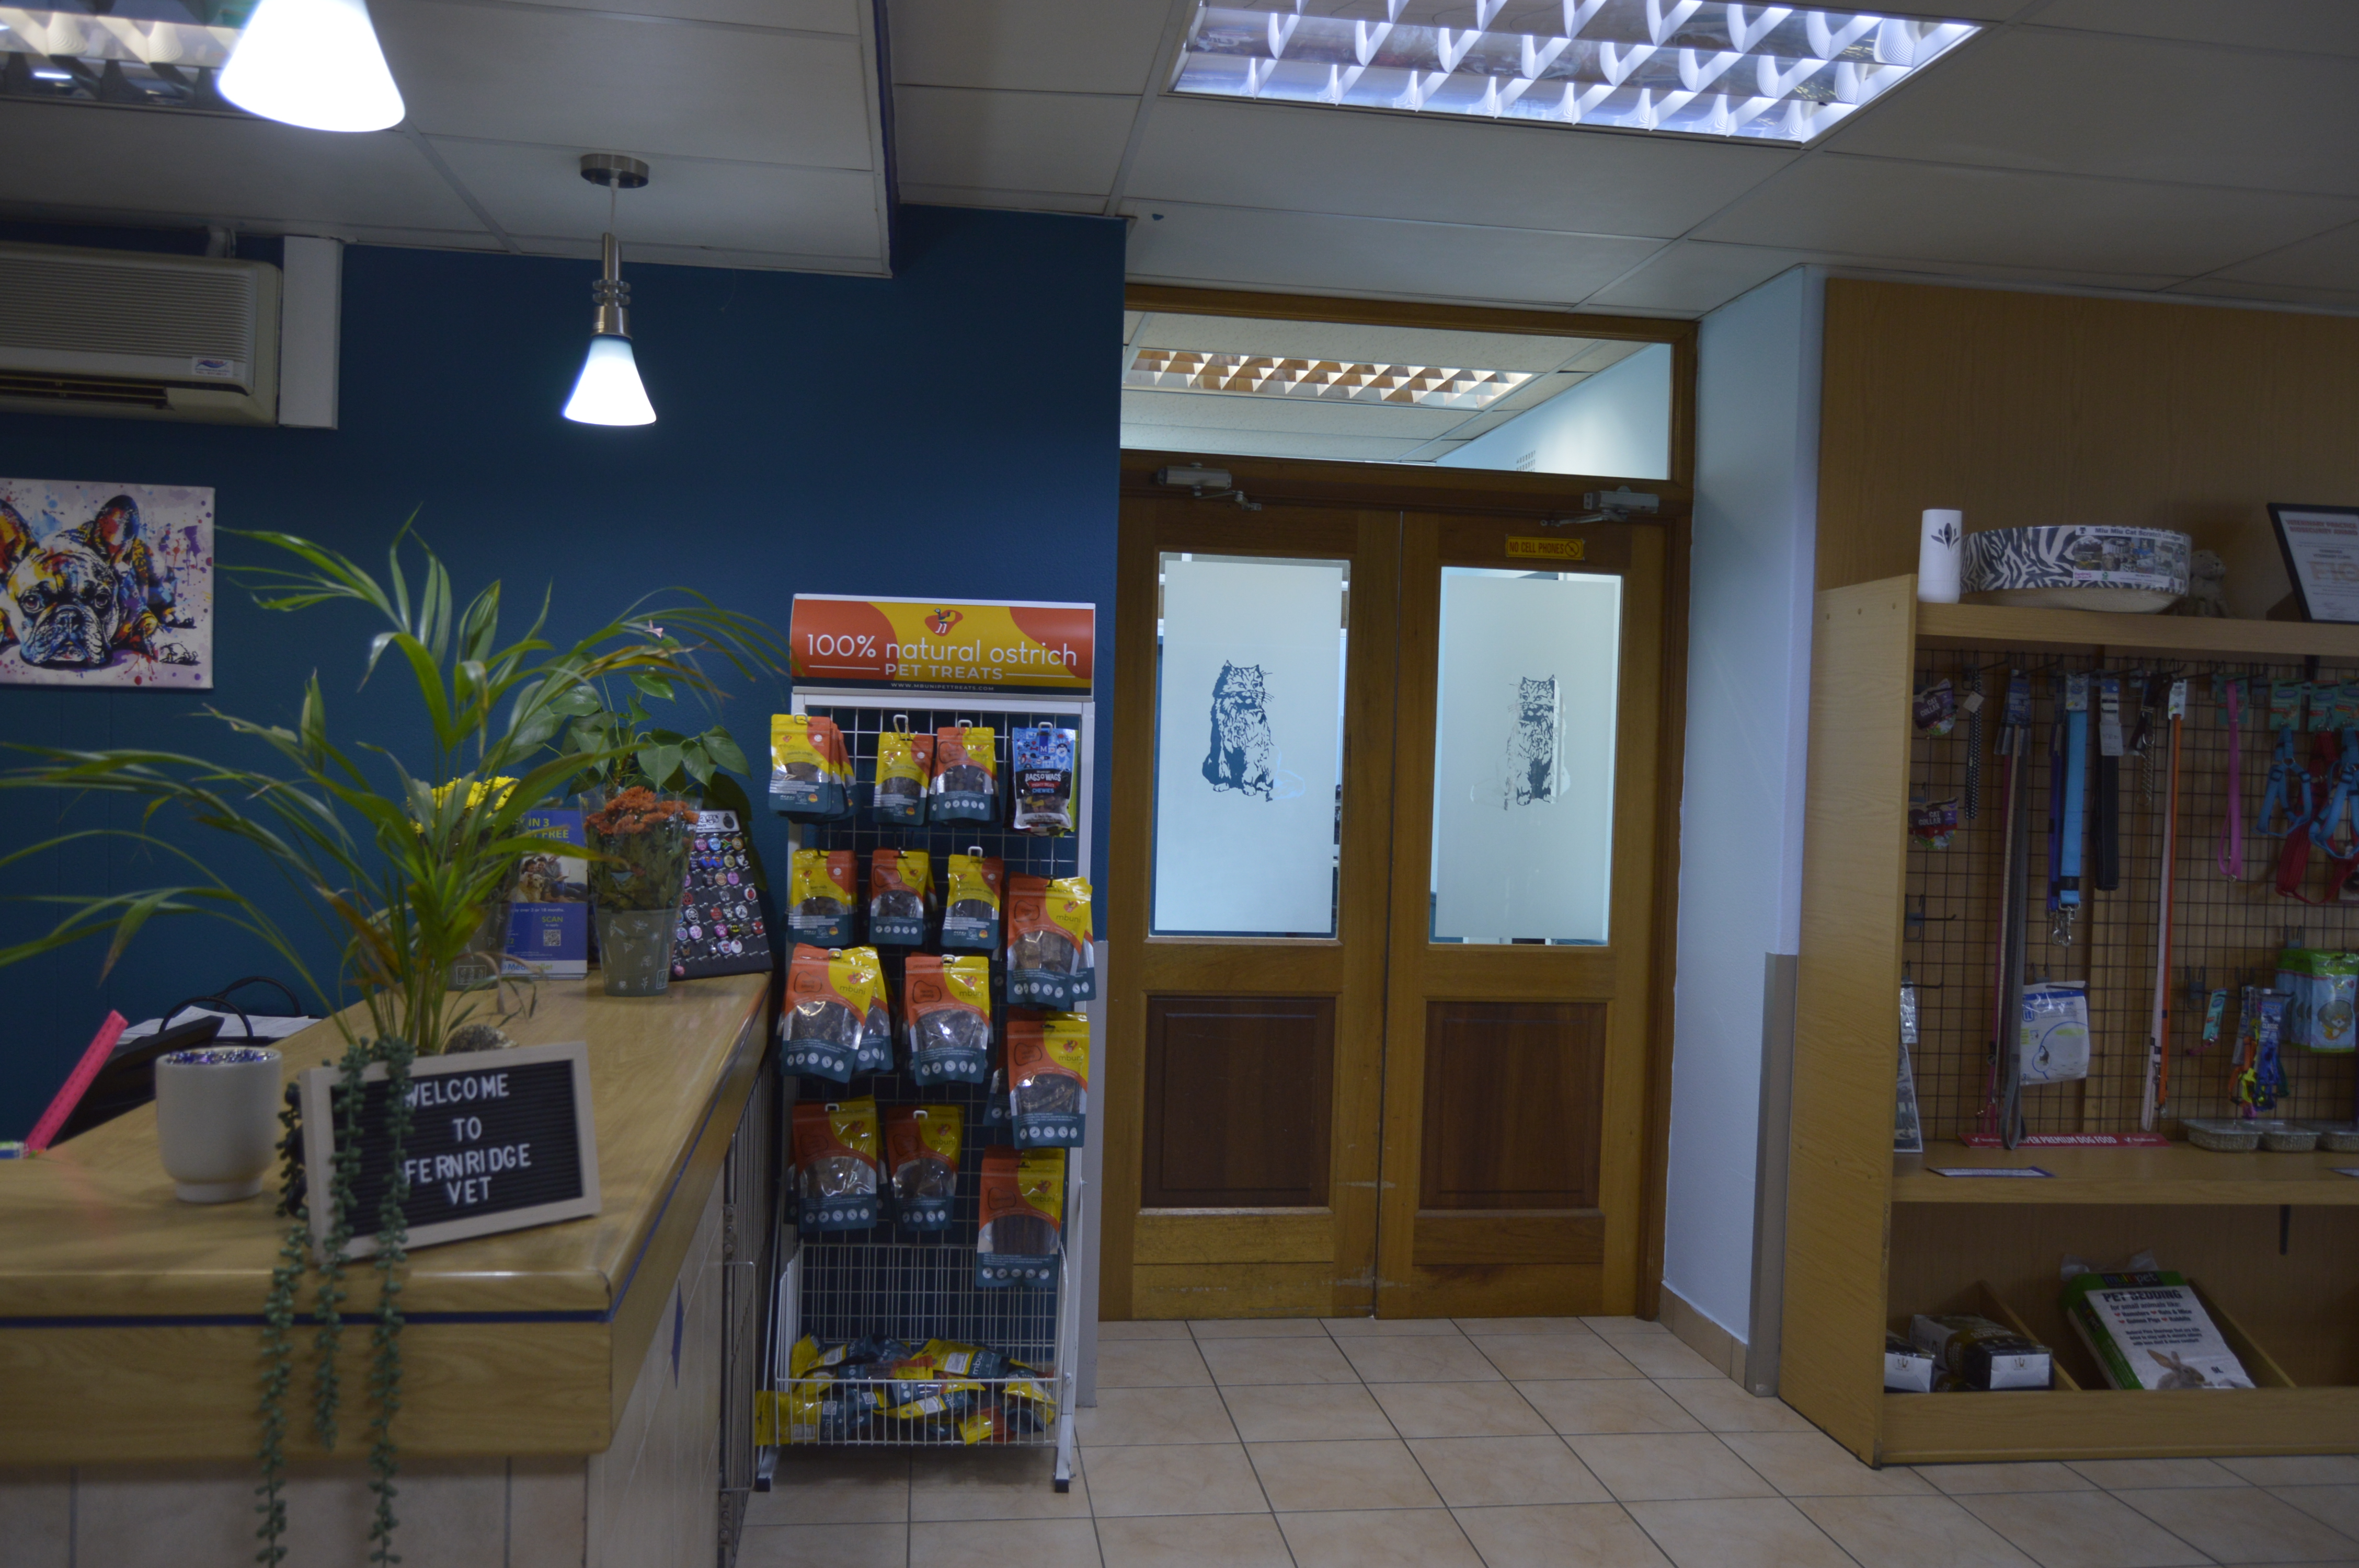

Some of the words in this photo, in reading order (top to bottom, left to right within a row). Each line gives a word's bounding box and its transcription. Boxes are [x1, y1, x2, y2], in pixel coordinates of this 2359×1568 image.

[1509, 541, 1519, 552] NO
[1521, 542, 1536, 553] CELL
[1539, 543, 1564, 554] PHONES
[808, 634, 877, 659] 100%
[886, 637, 980, 663] natural
[990, 641, 1078, 666] ostrich
[885, 663, 922, 677] PET
[928, 665, 1003, 680] TREATS
[891, 682, 994, 691] WWW.MBUNIPETTREATS.COM
[1926, 696, 1938, 707] CAT
[1919, 702, 1941, 718] COLLAR
[1025, 773, 1040, 782] BAGS
[1045, 774, 1062, 782] WAGS
[528, 817, 541, 827] IN
[543, 818, 550, 828] 3
[1918, 817, 1941, 826] COLLAR
[541, 829, 569, 839] FREE
[1056, 914, 1082, 924] mbuni
[839, 985, 866, 996] mbuni
[404, 1073, 510, 1108] WELCOME
[452, 1116, 482, 1143] TO
[2039, 1136, 2078, 1144] PREMIUM
[2076, 1136, 2095, 1144] DOG
[2093, 1136, 2117, 1144] FOOD
[404, 1143, 532, 1185] FERNRIDGE
[446, 1175, 493, 1205] VET
[2102, 1292, 2127, 1302] PET
[2128, 1289, 2183, 1301] BEDDING
